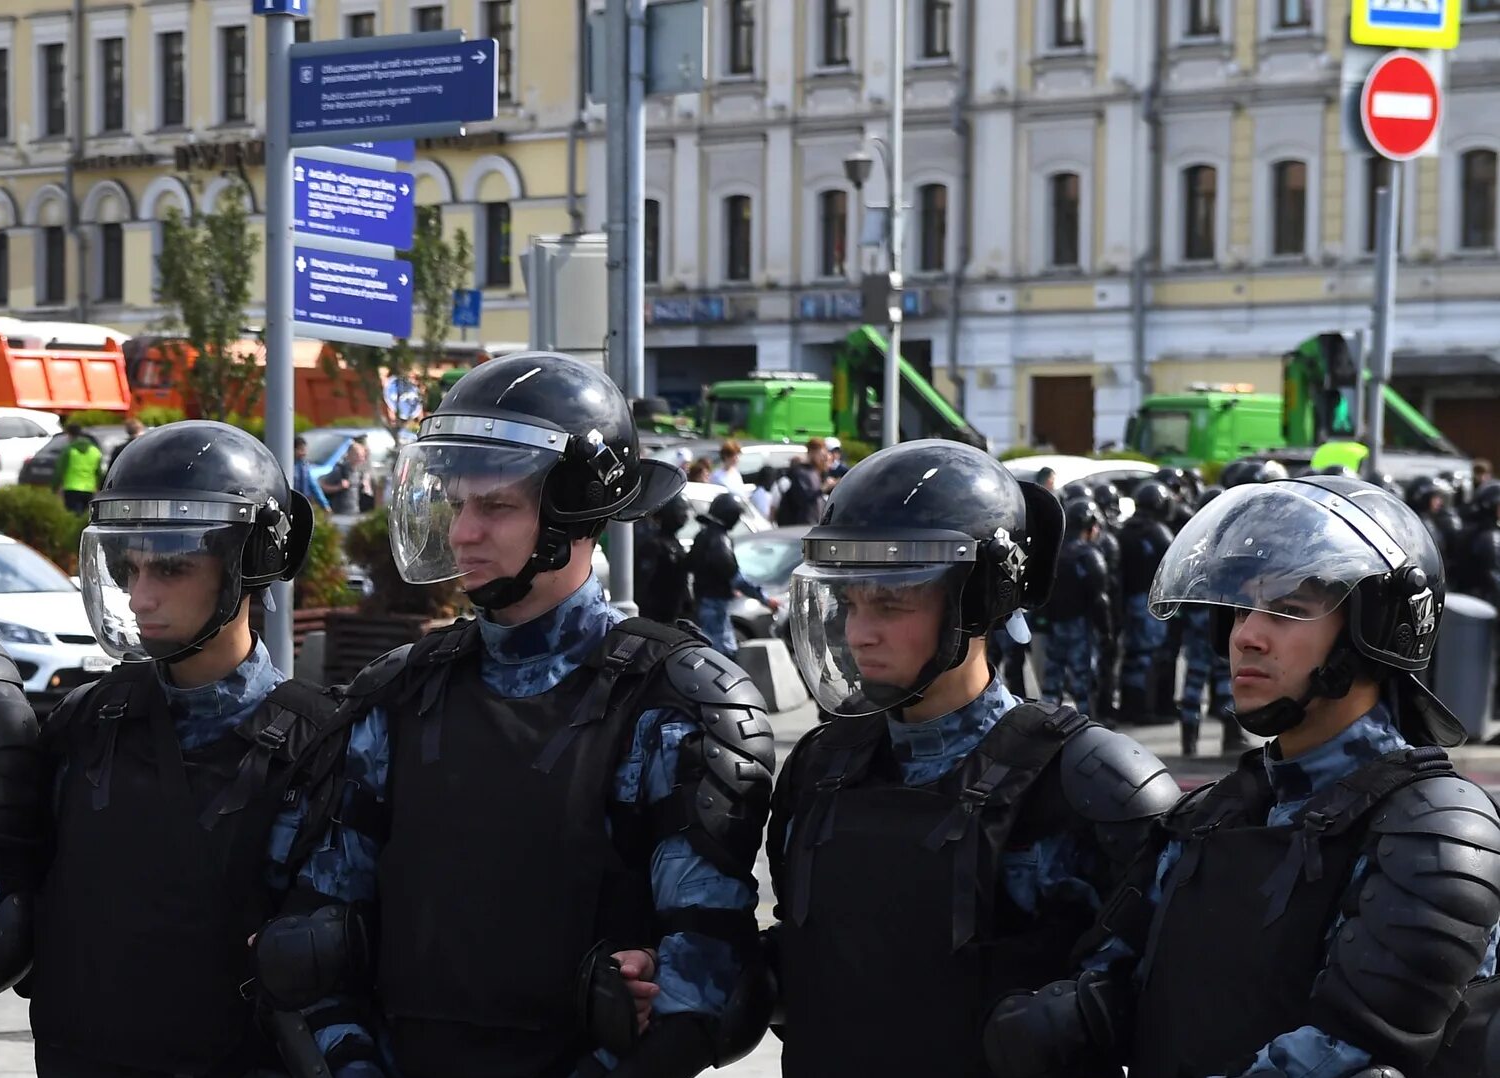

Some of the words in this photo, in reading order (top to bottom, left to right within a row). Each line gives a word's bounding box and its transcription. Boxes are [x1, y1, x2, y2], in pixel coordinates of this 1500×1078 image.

[321, 92, 345, 101] Public
[399, 84, 443, 95] monitoring
[379, 96, 411, 107] program
